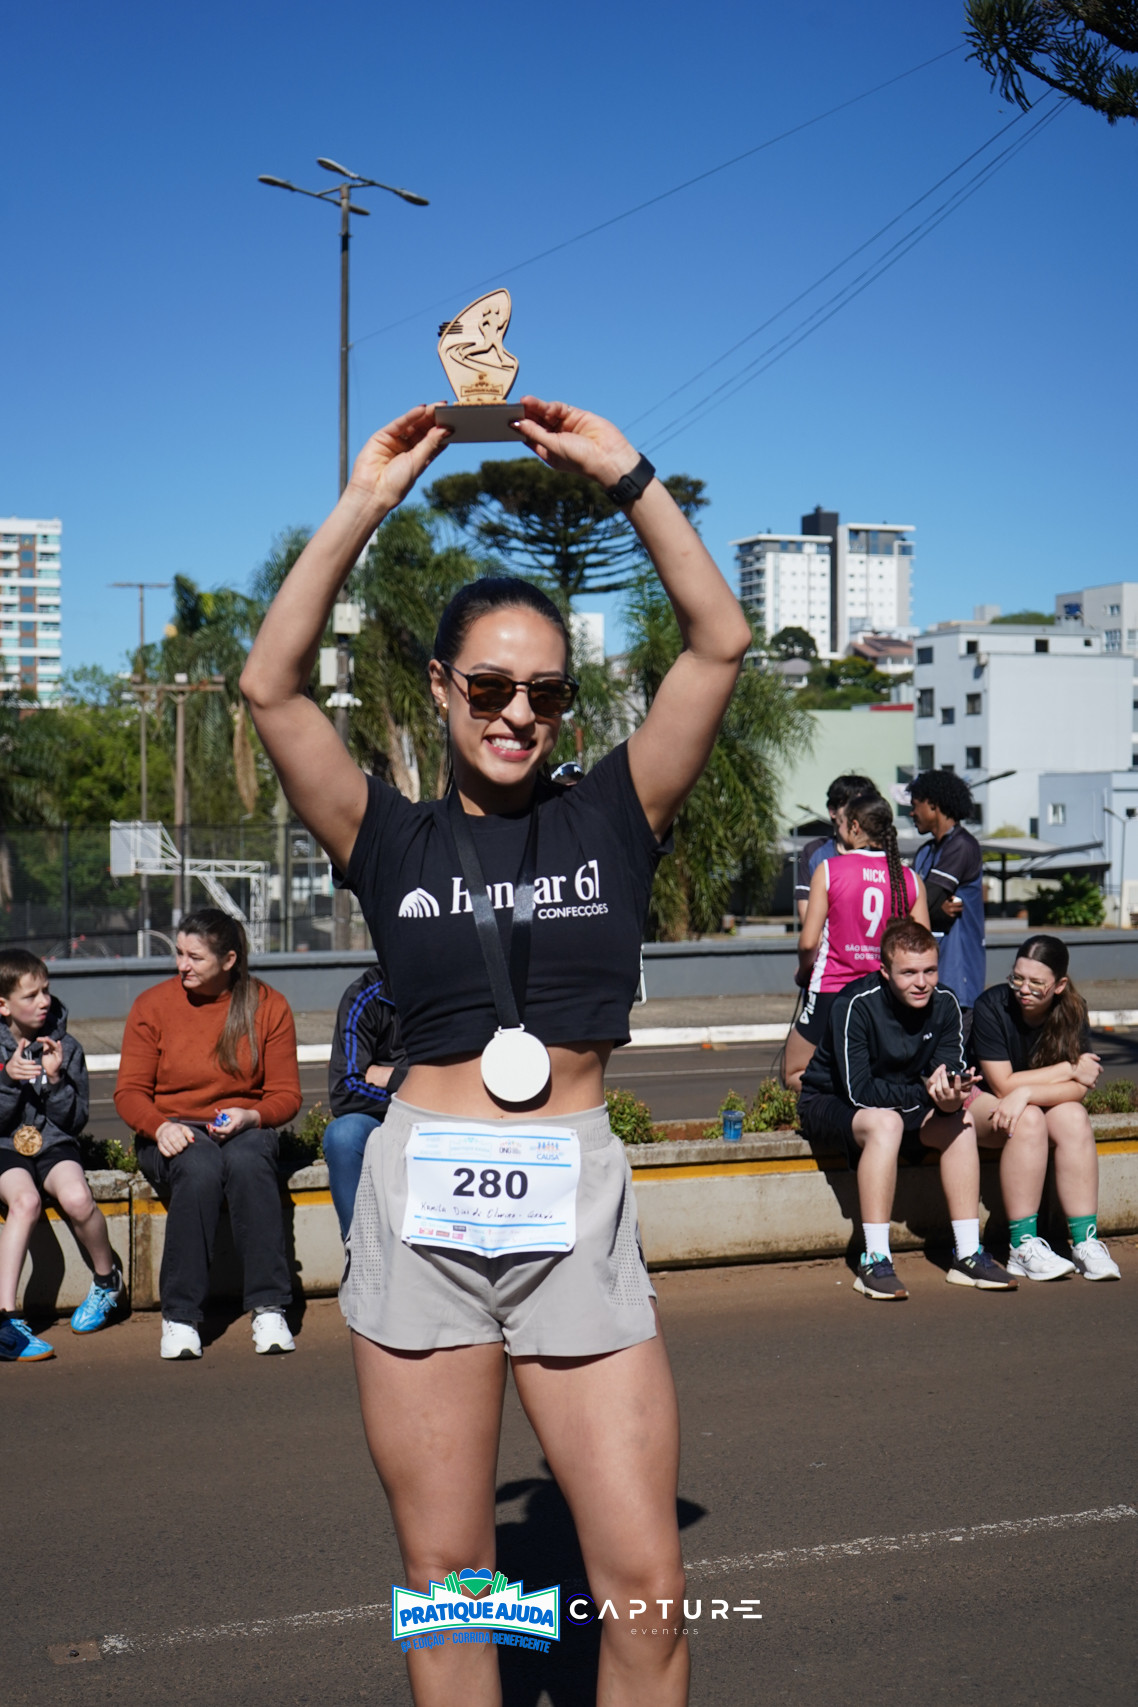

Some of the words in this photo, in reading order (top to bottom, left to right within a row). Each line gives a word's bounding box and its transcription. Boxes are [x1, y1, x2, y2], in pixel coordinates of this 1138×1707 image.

[450, 876, 567, 914] Hnar
[574, 860, 600, 901] 61
[862, 868, 886, 884] NICK
[537, 903, 609, 920] CONFECÇÕES
[862, 886, 885, 938] 9
[536, 1153, 560, 1161] CAUSA
[452, 1167, 529, 1200] 280
